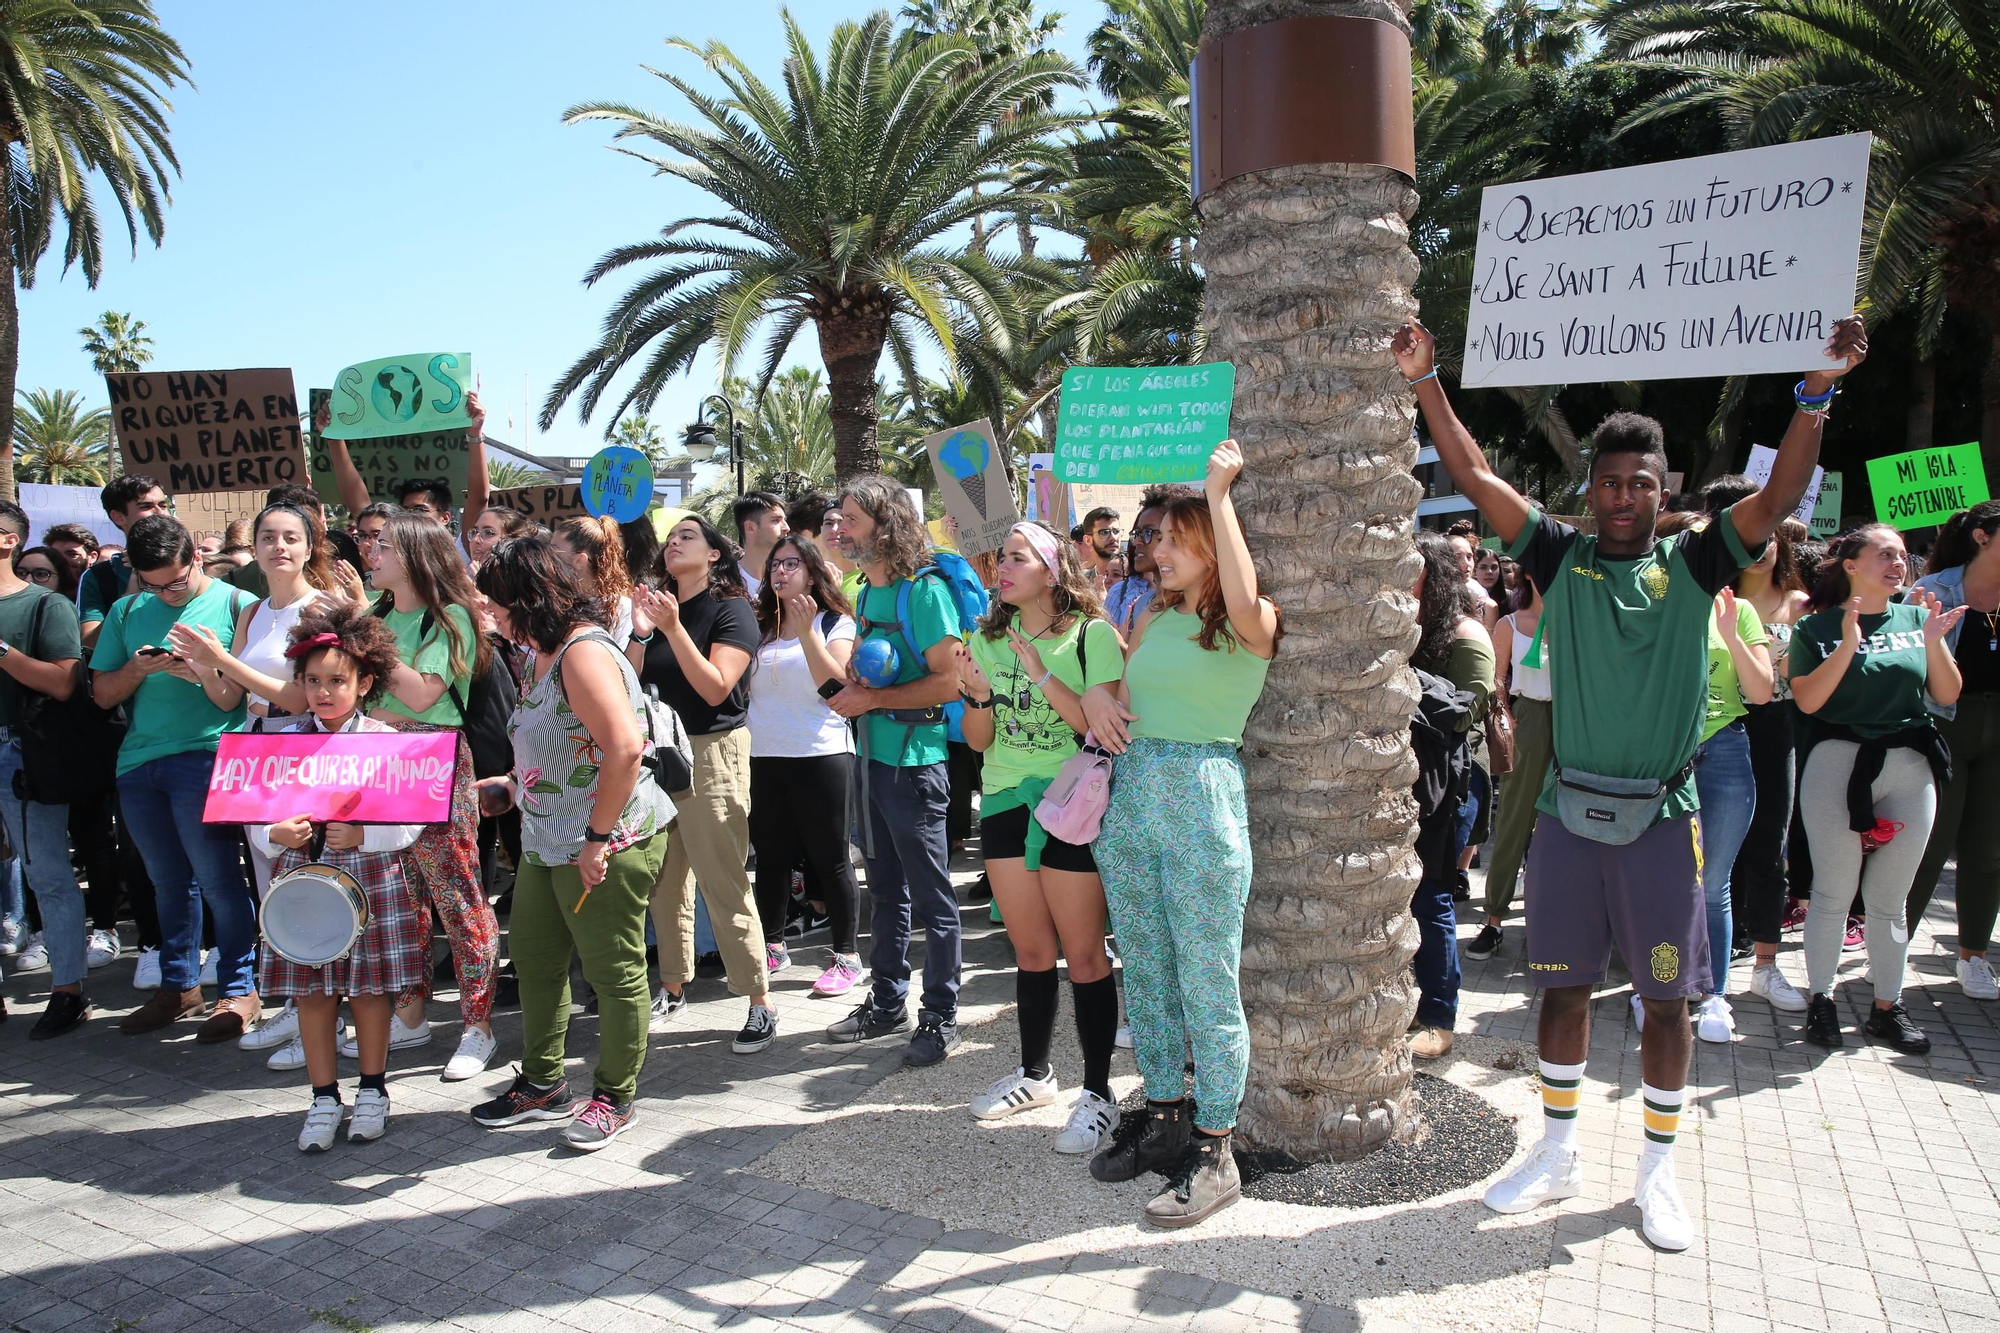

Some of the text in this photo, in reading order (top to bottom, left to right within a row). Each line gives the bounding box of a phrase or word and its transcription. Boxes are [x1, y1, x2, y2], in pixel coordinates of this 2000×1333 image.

[1628, 263, 1646, 290] A
[1720, 304, 1826, 347] AVENIR
[108, 372, 228, 404] NO HAY
[1069, 370, 1210, 392] SI LOS ÁRBOLES
[121, 399, 255, 431] RIQUEZA
[263, 393, 299, 420] EN
[1069, 401, 1228, 418] DIERAN WIFI TODOS
[1064, 417, 1207, 439] LOS PLANTARÍAN
[129, 433, 181, 464] UN
[1060, 442, 1094, 459] QUE
[1098, 443, 1145, 461] PENA
[1146, 443, 1172, 457] QUE
[170, 456, 296, 491] MUERTO
[414, 455, 449, 472] NO
[603, 459, 634, 473] NO HAY
[1066, 462, 1100, 478] DEN
[20, 484, 49, 508] NO
[594, 472, 633, 498] PLANETA
[607, 499, 616, 515] B
[961, 514, 1017, 540] NOS QUEDAMOS
[964, 540, 981, 556] SIN
[211, 756, 258, 792] HAY
[261, 755, 299, 789] QUE
[361, 755, 386, 789] AL
[386, 754, 455, 796] MUNDO
